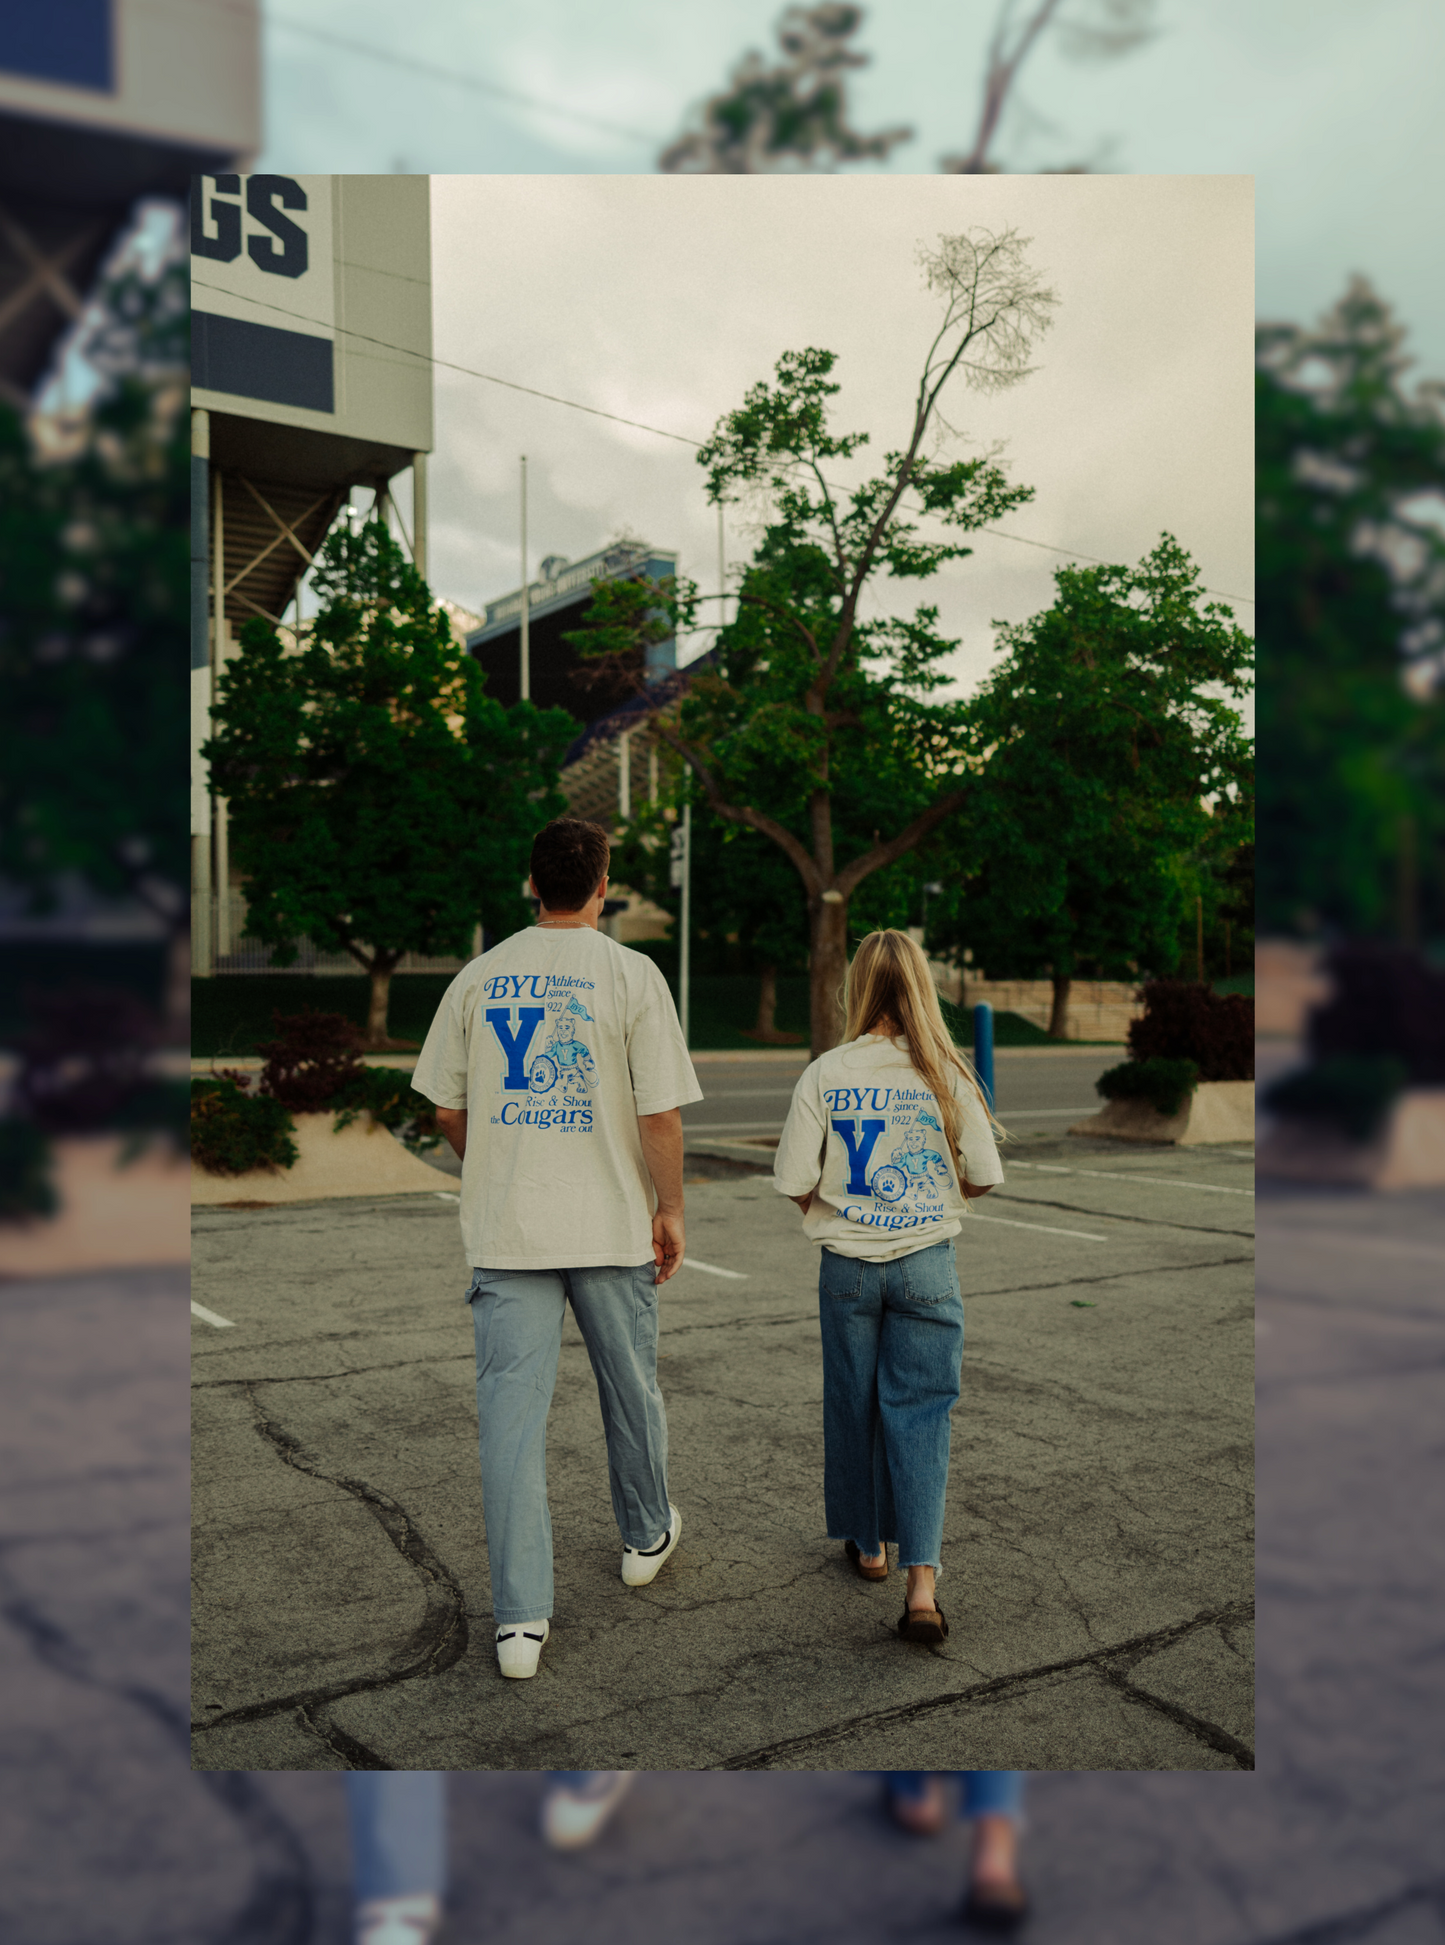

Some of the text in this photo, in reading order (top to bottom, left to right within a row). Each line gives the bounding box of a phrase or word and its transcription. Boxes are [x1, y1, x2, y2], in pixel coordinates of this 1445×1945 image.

[191, 175, 309, 280] GS
[483, 974, 596, 999] BYU Athletics
[547, 986, 572, 999] since
[570, 1003, 585, 1014] BYU
[484, 1005, 545, 1091] Y
[525, 1095, 593, 1107] Rise & Shout
[823, 1088, 893, 1112] BYU
[892, 1100, 919, 1113] since
[490, 1102, 594, 1130] the Cougars
[891, 1115, 911, 1126] 1922
[920, 1115, 935, 1124] BYU
[560, 1124, 594, 1133] are out
[831, 1117, 887, 1198] Y
[911, 1157, 919, 1170] Y
[873, 1202, 944, 1214] Rise & Shout
